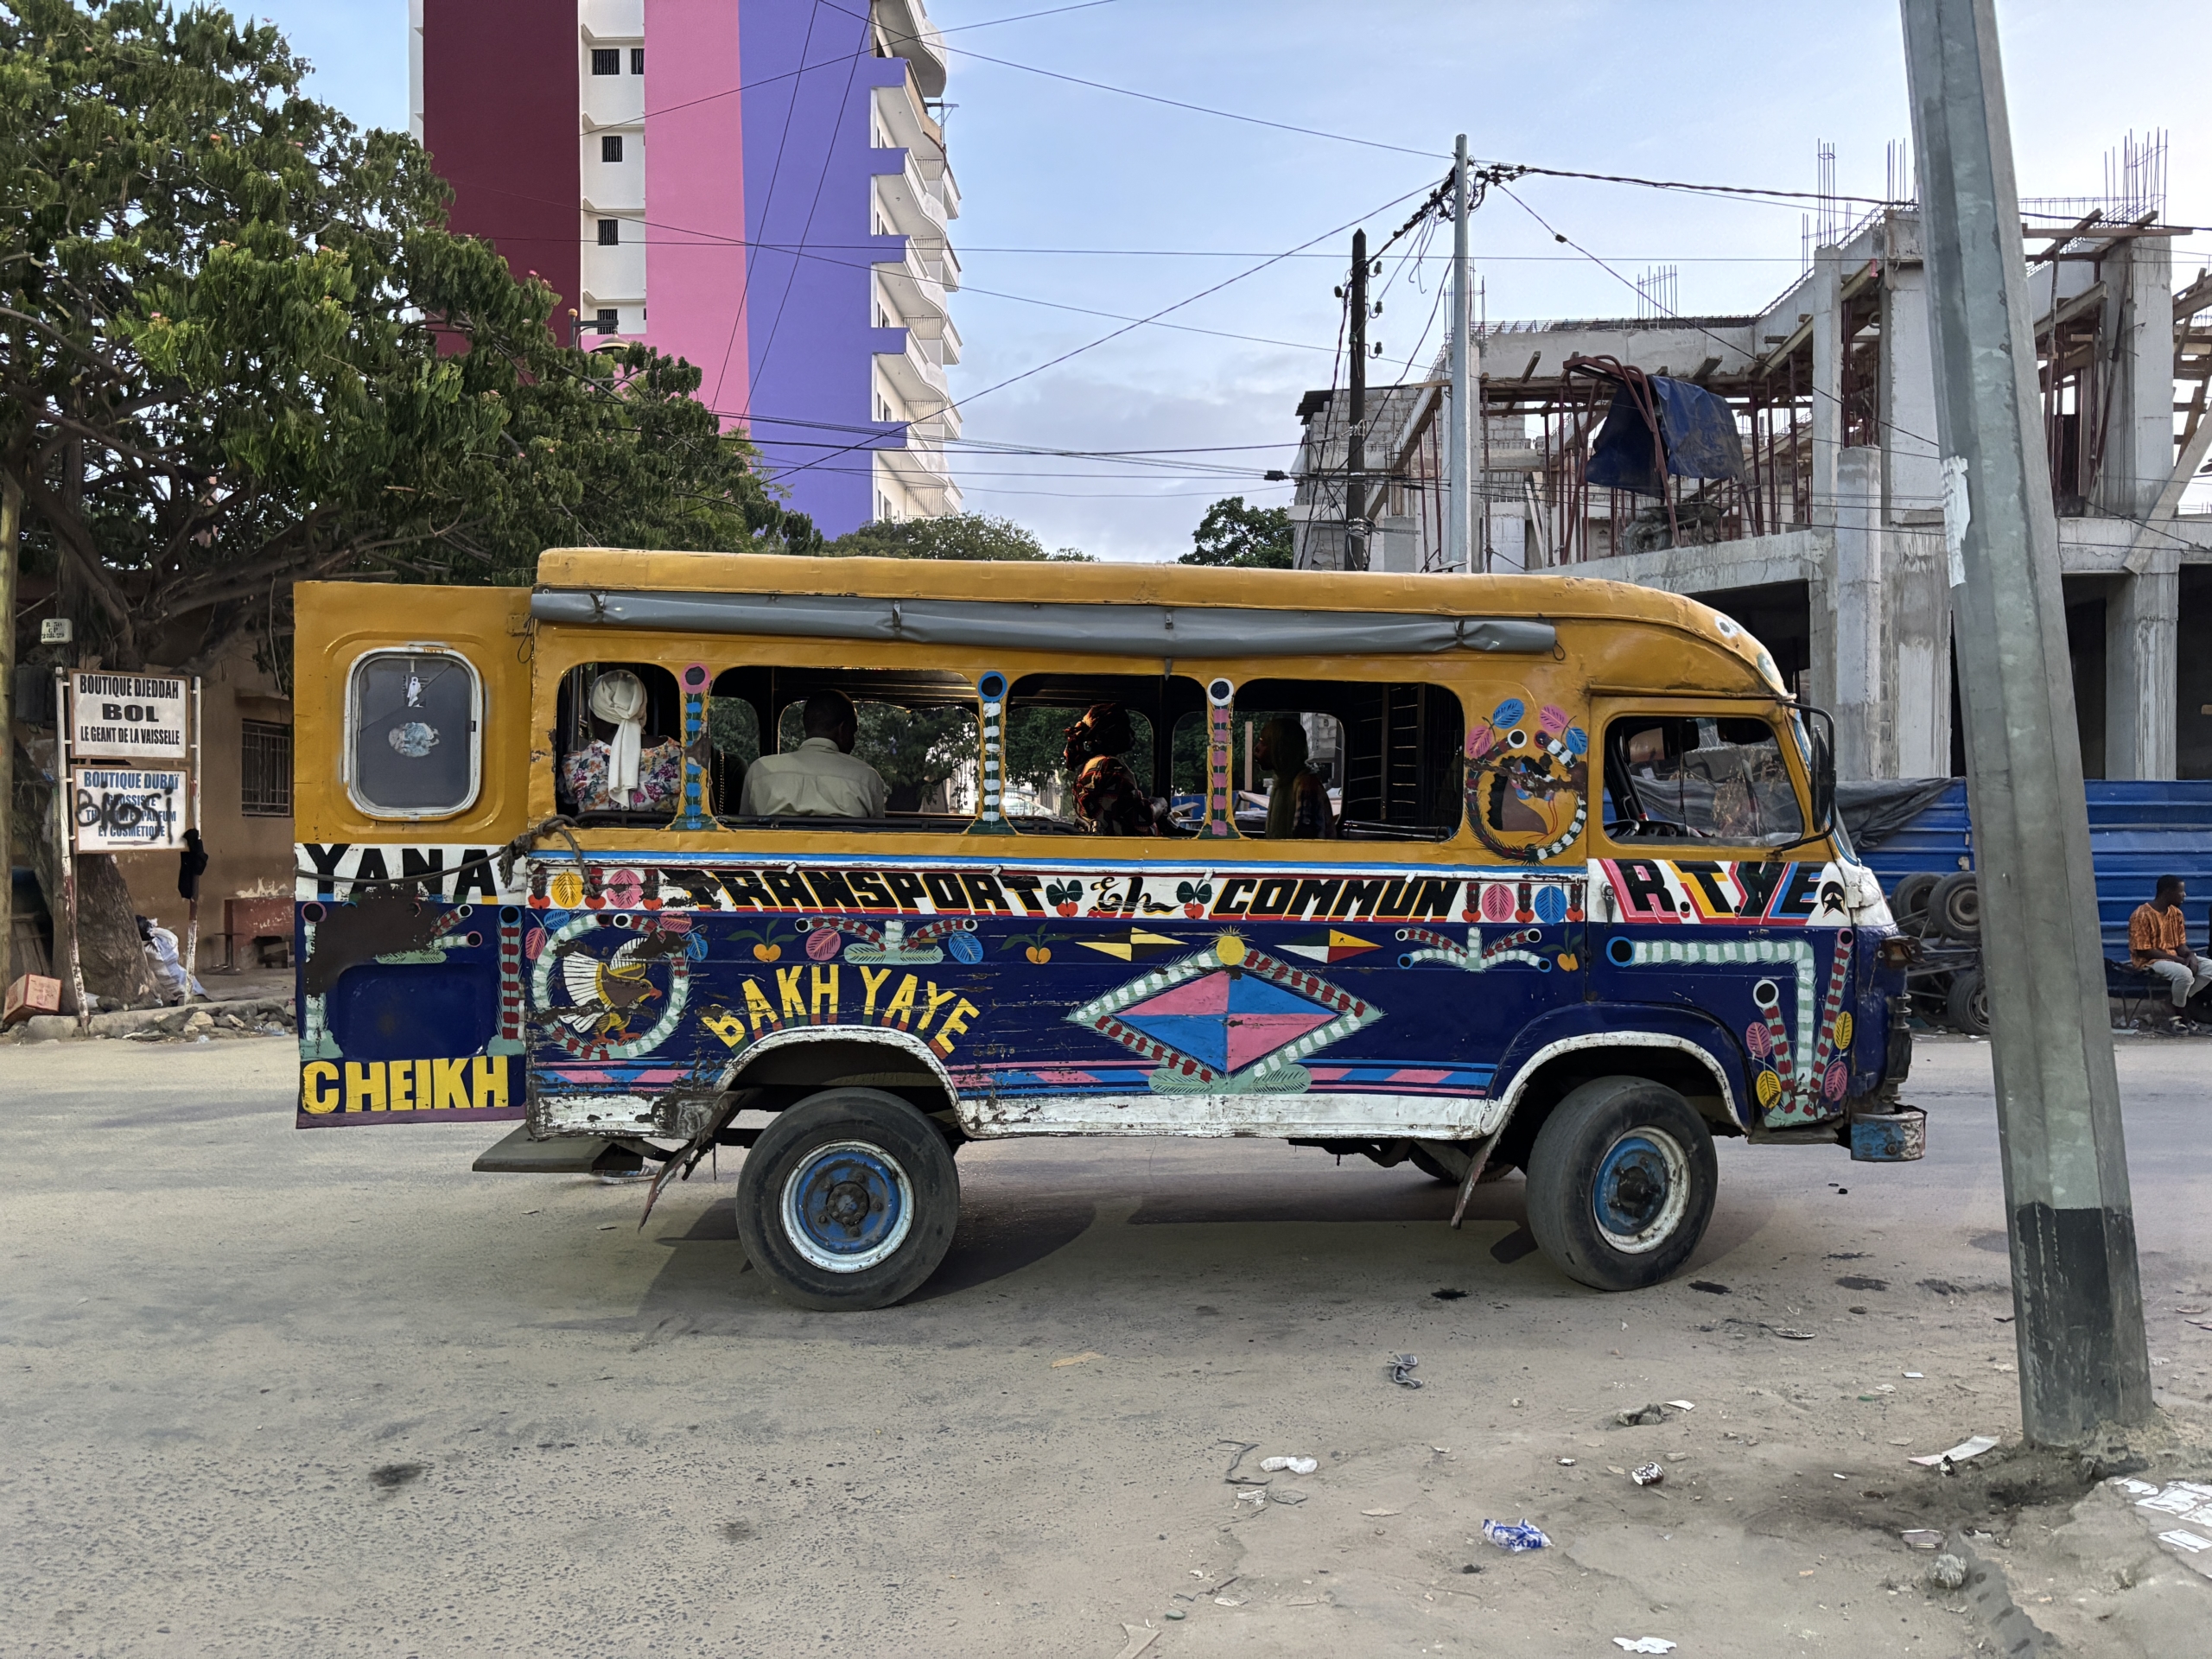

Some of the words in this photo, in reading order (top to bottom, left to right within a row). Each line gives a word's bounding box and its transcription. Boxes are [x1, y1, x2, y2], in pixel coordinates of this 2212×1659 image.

[79, 674, 132, 697] BOUTIQUE
[134, 678, 179, 699] DJEDDAH
[102, 703, 159, 722] BOL
[80, 726, 89, 741] LE
[91, 726, 117, 742] GEANT
[118, 728, 129, 743] DE
[130, 728, 140, 744] LA
[141, 728, 180, 745] VAISSELLE
[84, 771, 142, 790] BOUTIQUE
[143, 773, 180, 790] DUBAÏ
[107, 794, 156, 806] GOSSISE
[302, 843, 499, 905] YANA
[659, 868, 1046, 917] TRANSPORT
[1211, 878, 1461, 922] COMMUN
[700, 965, 839, 1055] BAKH
[859, 967, 980, 1059] YAYE
[302, 1056, 508, 1113] CHEIKH
